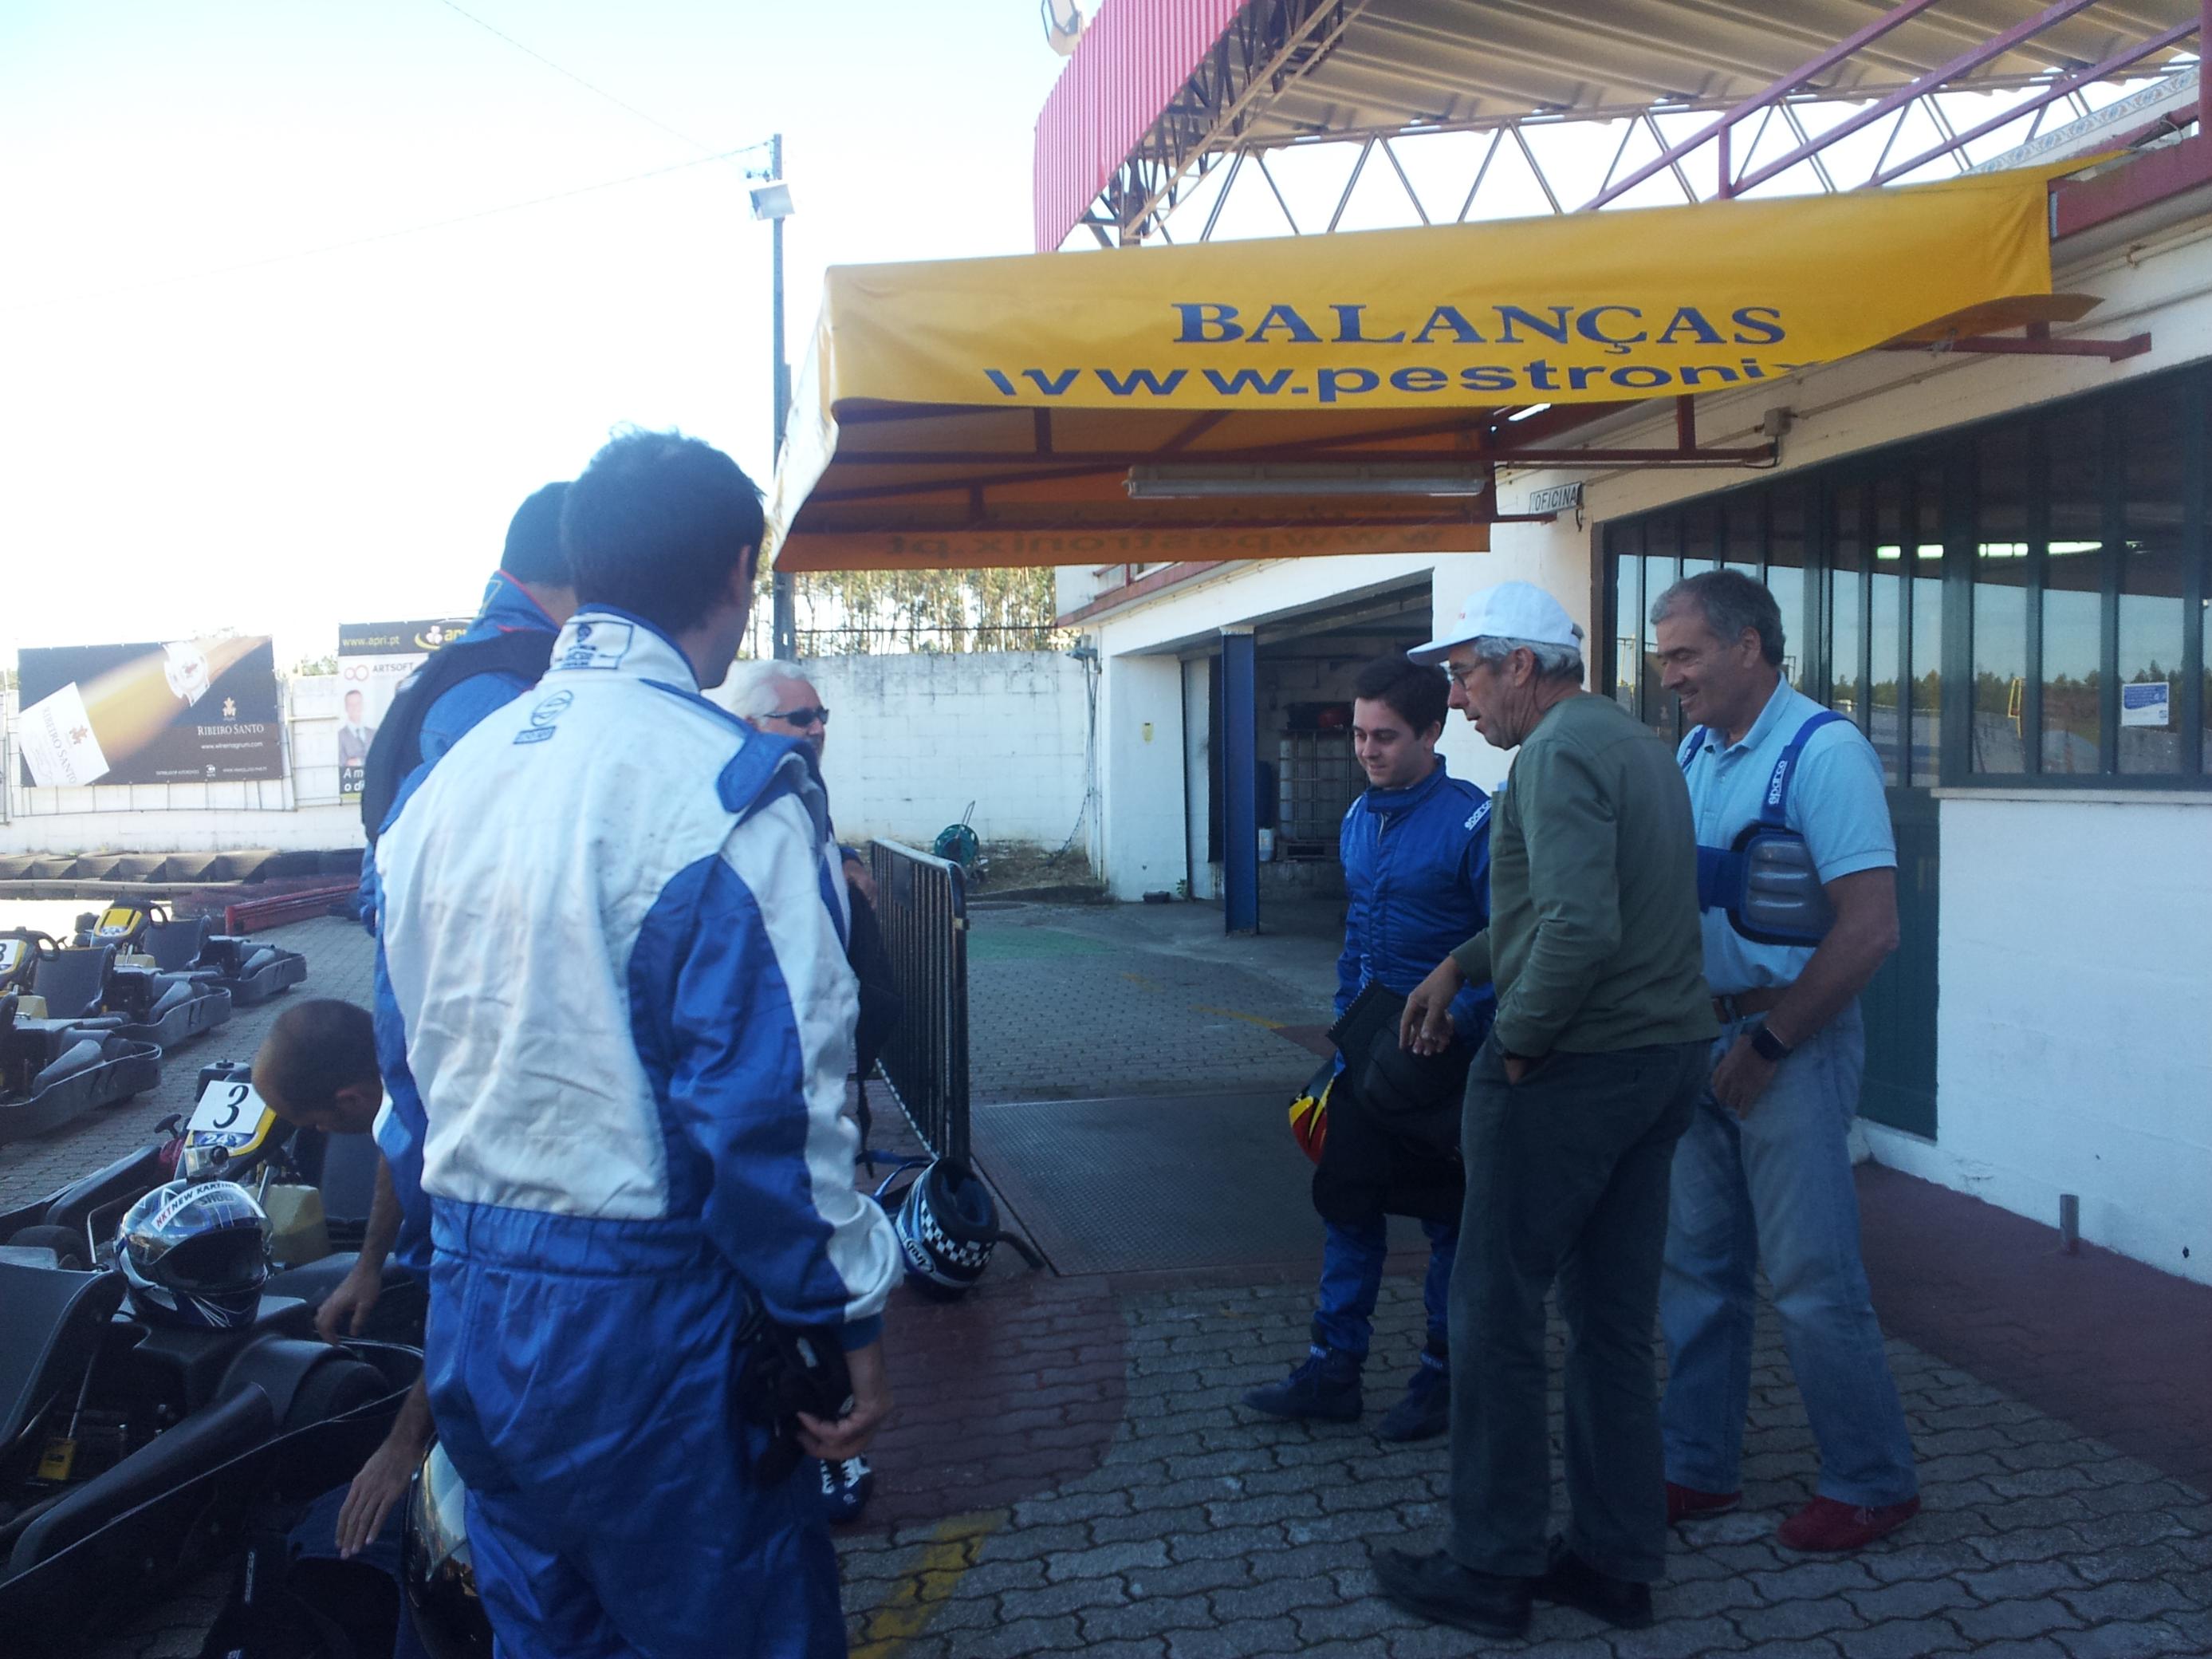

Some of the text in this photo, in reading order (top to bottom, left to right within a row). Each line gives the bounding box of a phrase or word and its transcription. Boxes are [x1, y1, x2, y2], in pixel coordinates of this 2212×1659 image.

[1171, 303, 1786, 354] BALANÇAS
[983, 359, 1821, 402] www.pestroni
[1534, 486, 1577, 511] OFICINA
[343, 635, 400, 647] www.apri.pt
[372, 662, 414, 673] ARTSOFT
[198, 723, 264, 735] RIBEIRO SANTO
[57, 749, 77, 783] SANTO
[343, 767, 352, 778] A
[344, 783, 352, 792] o
[213, 1085, 250, 1129] 3
[171, 1191, 193, 1209] NEW
